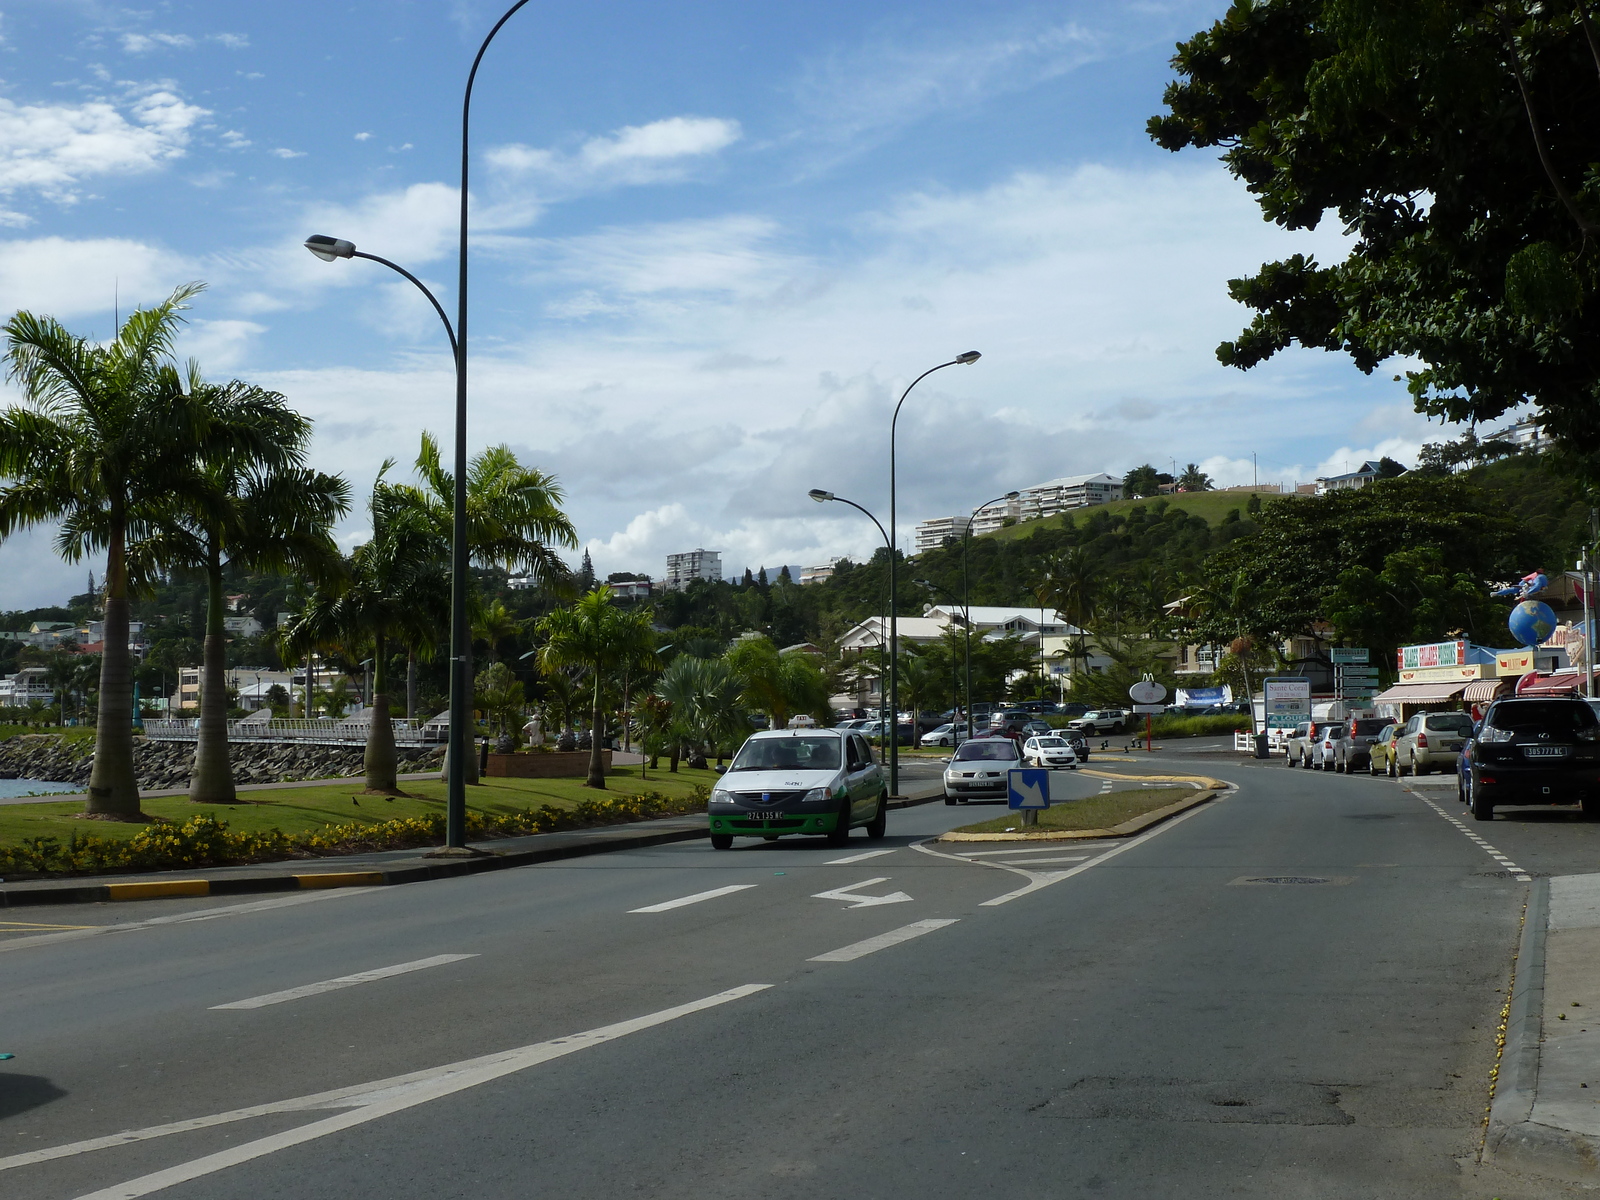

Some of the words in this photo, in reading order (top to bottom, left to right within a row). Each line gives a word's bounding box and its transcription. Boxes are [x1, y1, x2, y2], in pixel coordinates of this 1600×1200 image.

[1554, 747, 1562, 755] NC
[748, 812, 760, 820] 274
[762, 812, 774, 820] 135
[774, 811, 783, 819] NC
